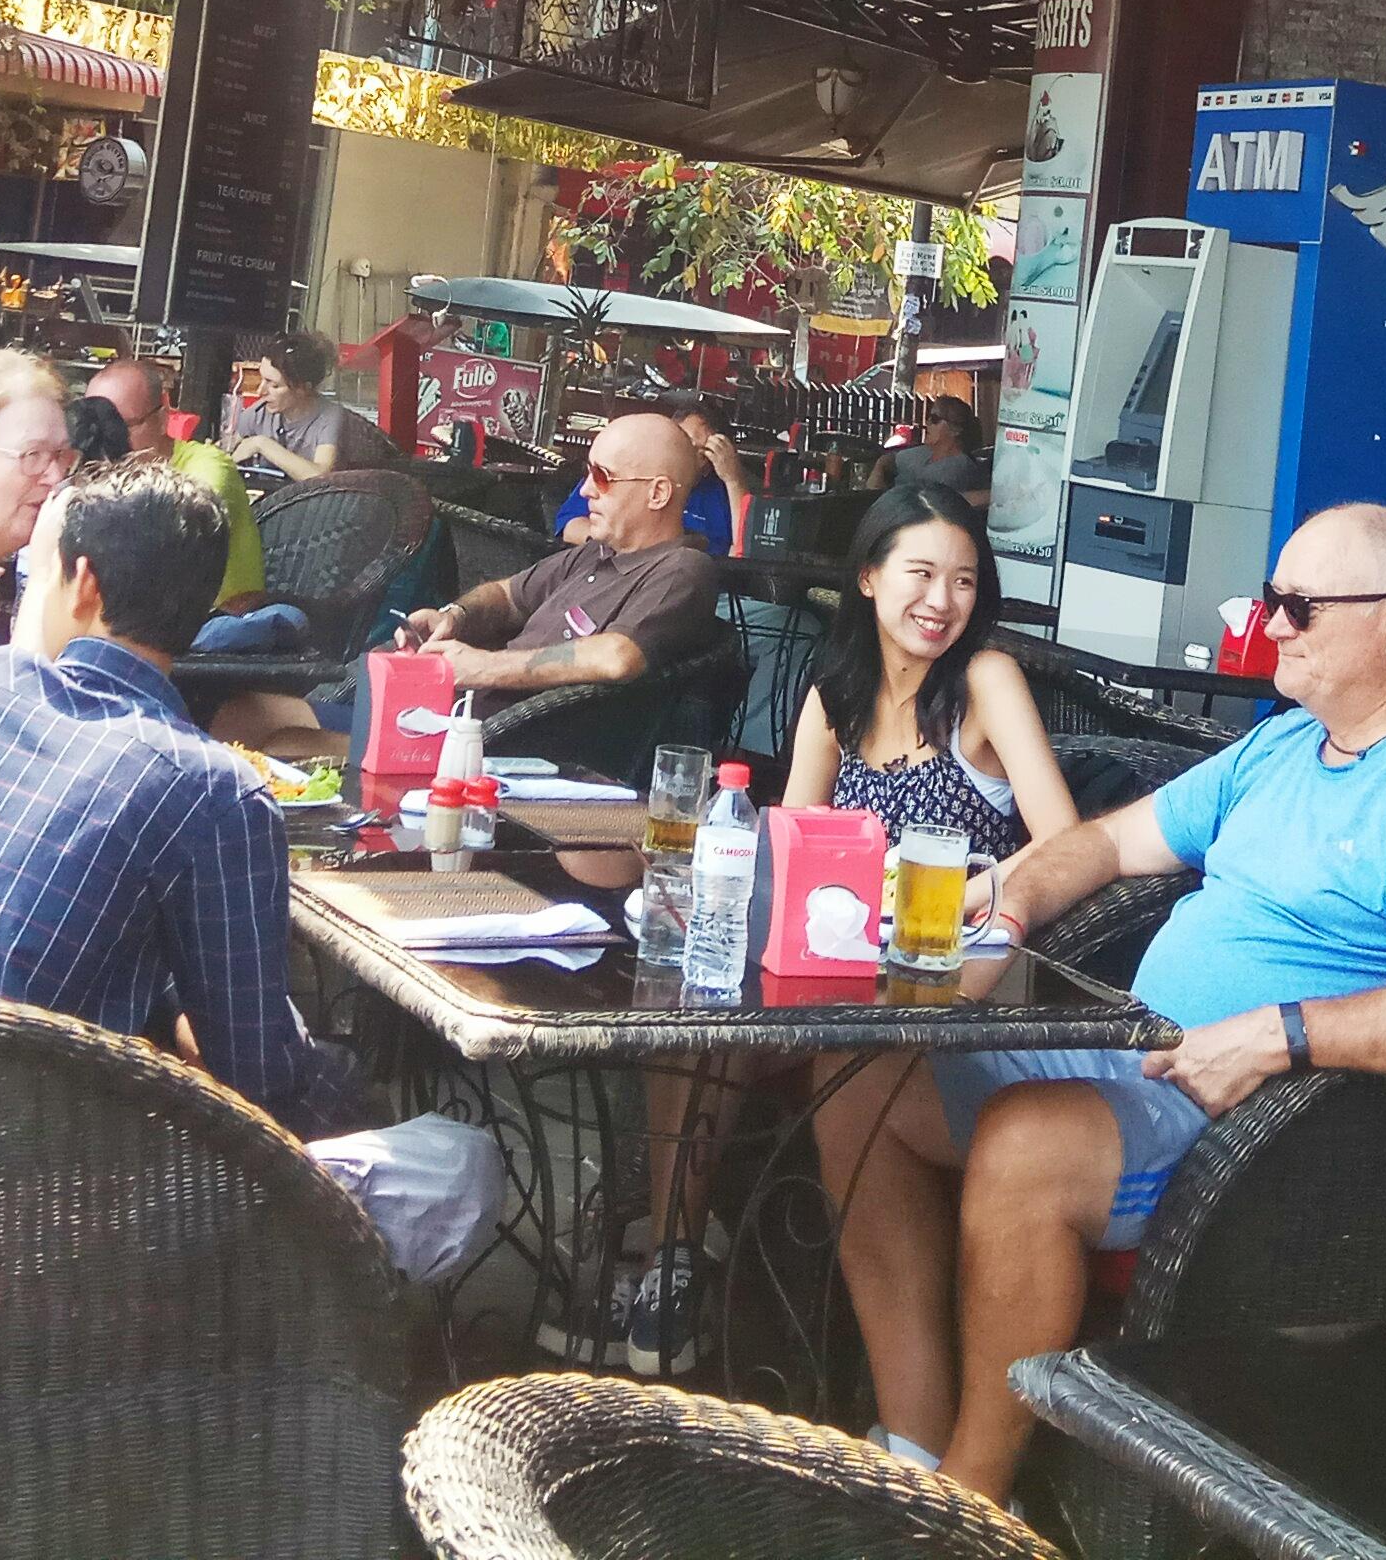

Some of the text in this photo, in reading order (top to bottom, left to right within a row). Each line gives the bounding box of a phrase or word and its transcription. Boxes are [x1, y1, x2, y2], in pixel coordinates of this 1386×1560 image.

[1251, 92, 1332, 103] VISA VISA
[1196, 130, 1304, 191] ATM
[453, 363, 496, 390] Fullo
